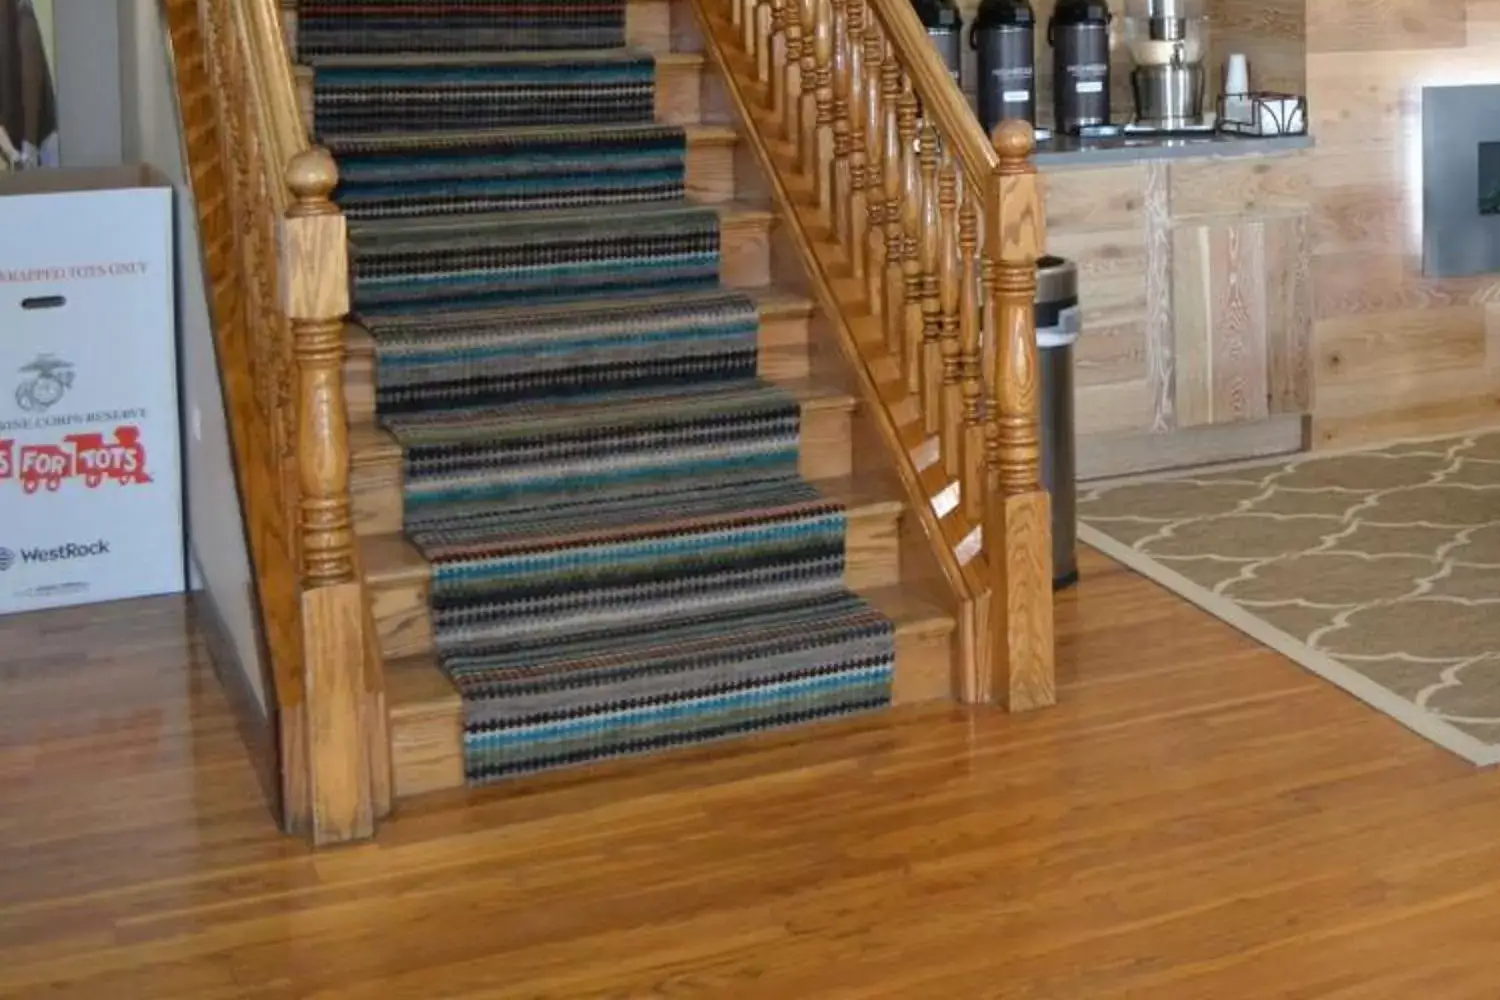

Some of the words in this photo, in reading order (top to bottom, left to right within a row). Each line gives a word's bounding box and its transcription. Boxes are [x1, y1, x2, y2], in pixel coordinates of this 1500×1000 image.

[23, 450, 65, 474] FOR
[80, 447, 138, 471] TOTS
[20, 539, 111, 564] WestRock
